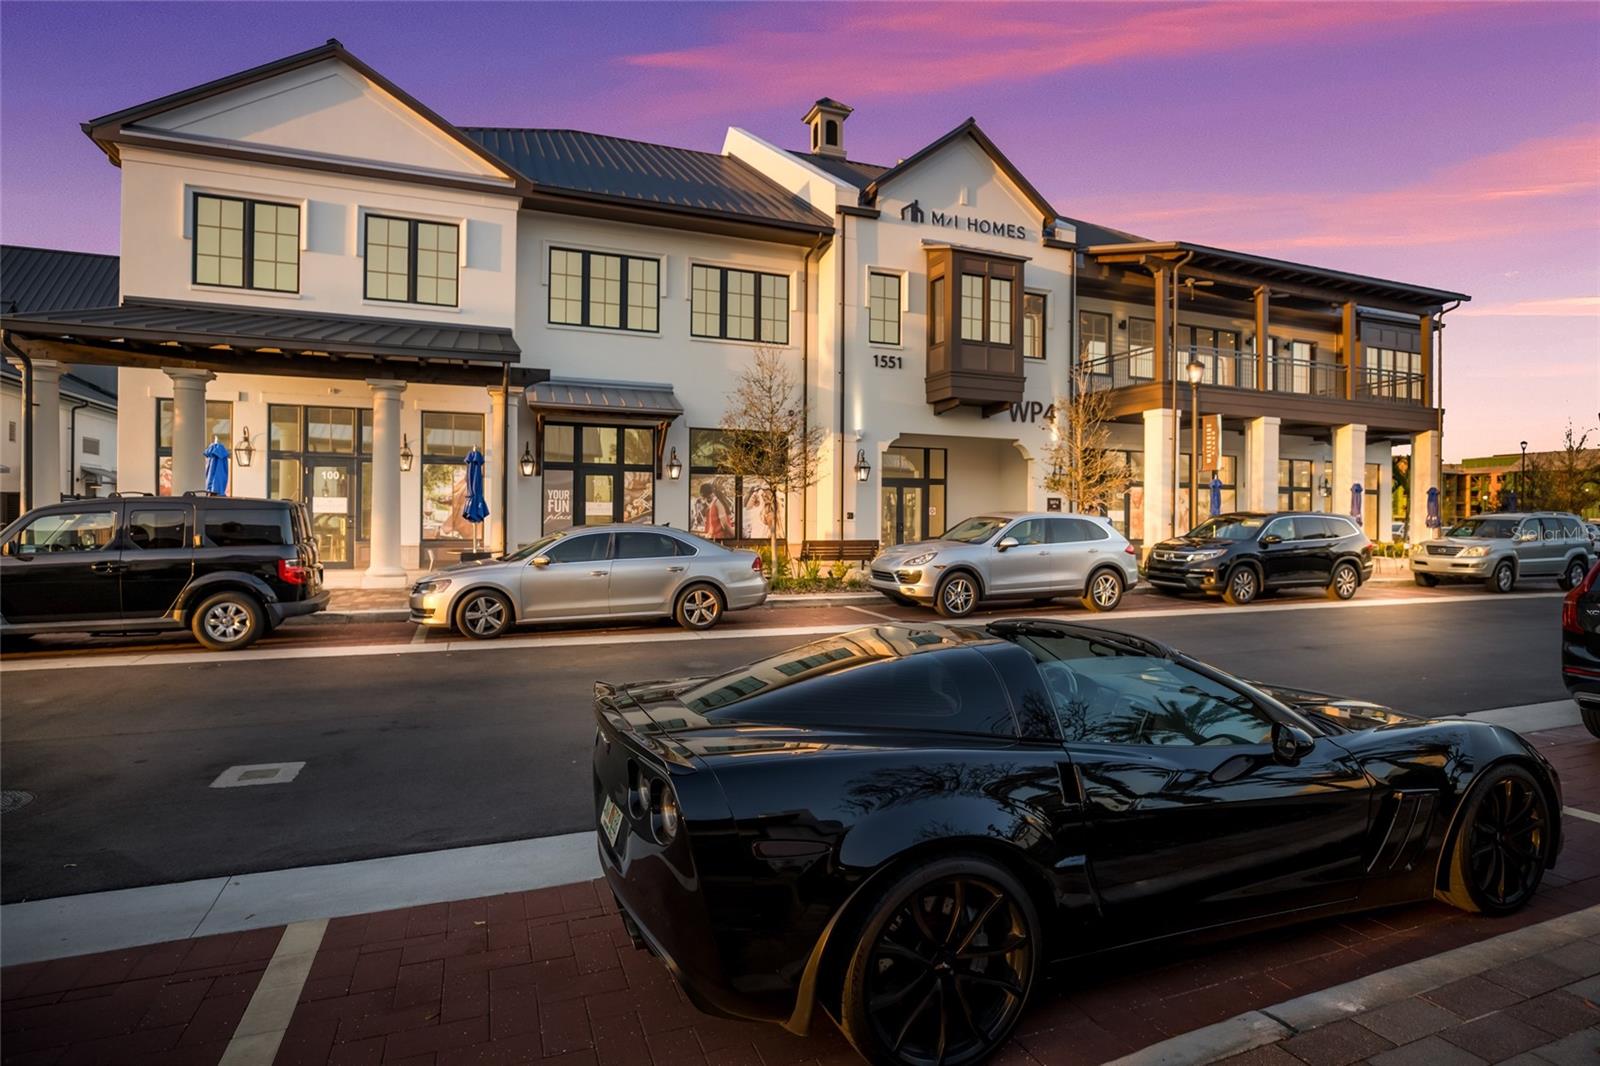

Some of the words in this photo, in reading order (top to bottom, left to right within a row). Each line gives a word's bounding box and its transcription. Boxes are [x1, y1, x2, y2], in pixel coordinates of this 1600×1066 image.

[967, 217, 1026, 240] HOMES
[873, 354, 903, 369] 1551
[1008, 400, 1057, 424] WP4
[321, 470, 340, 480] 100
[547, 489, 570, 500] YOUR
[547, 500, 570, 513] FUN
[543, 512, 572, 524] place
